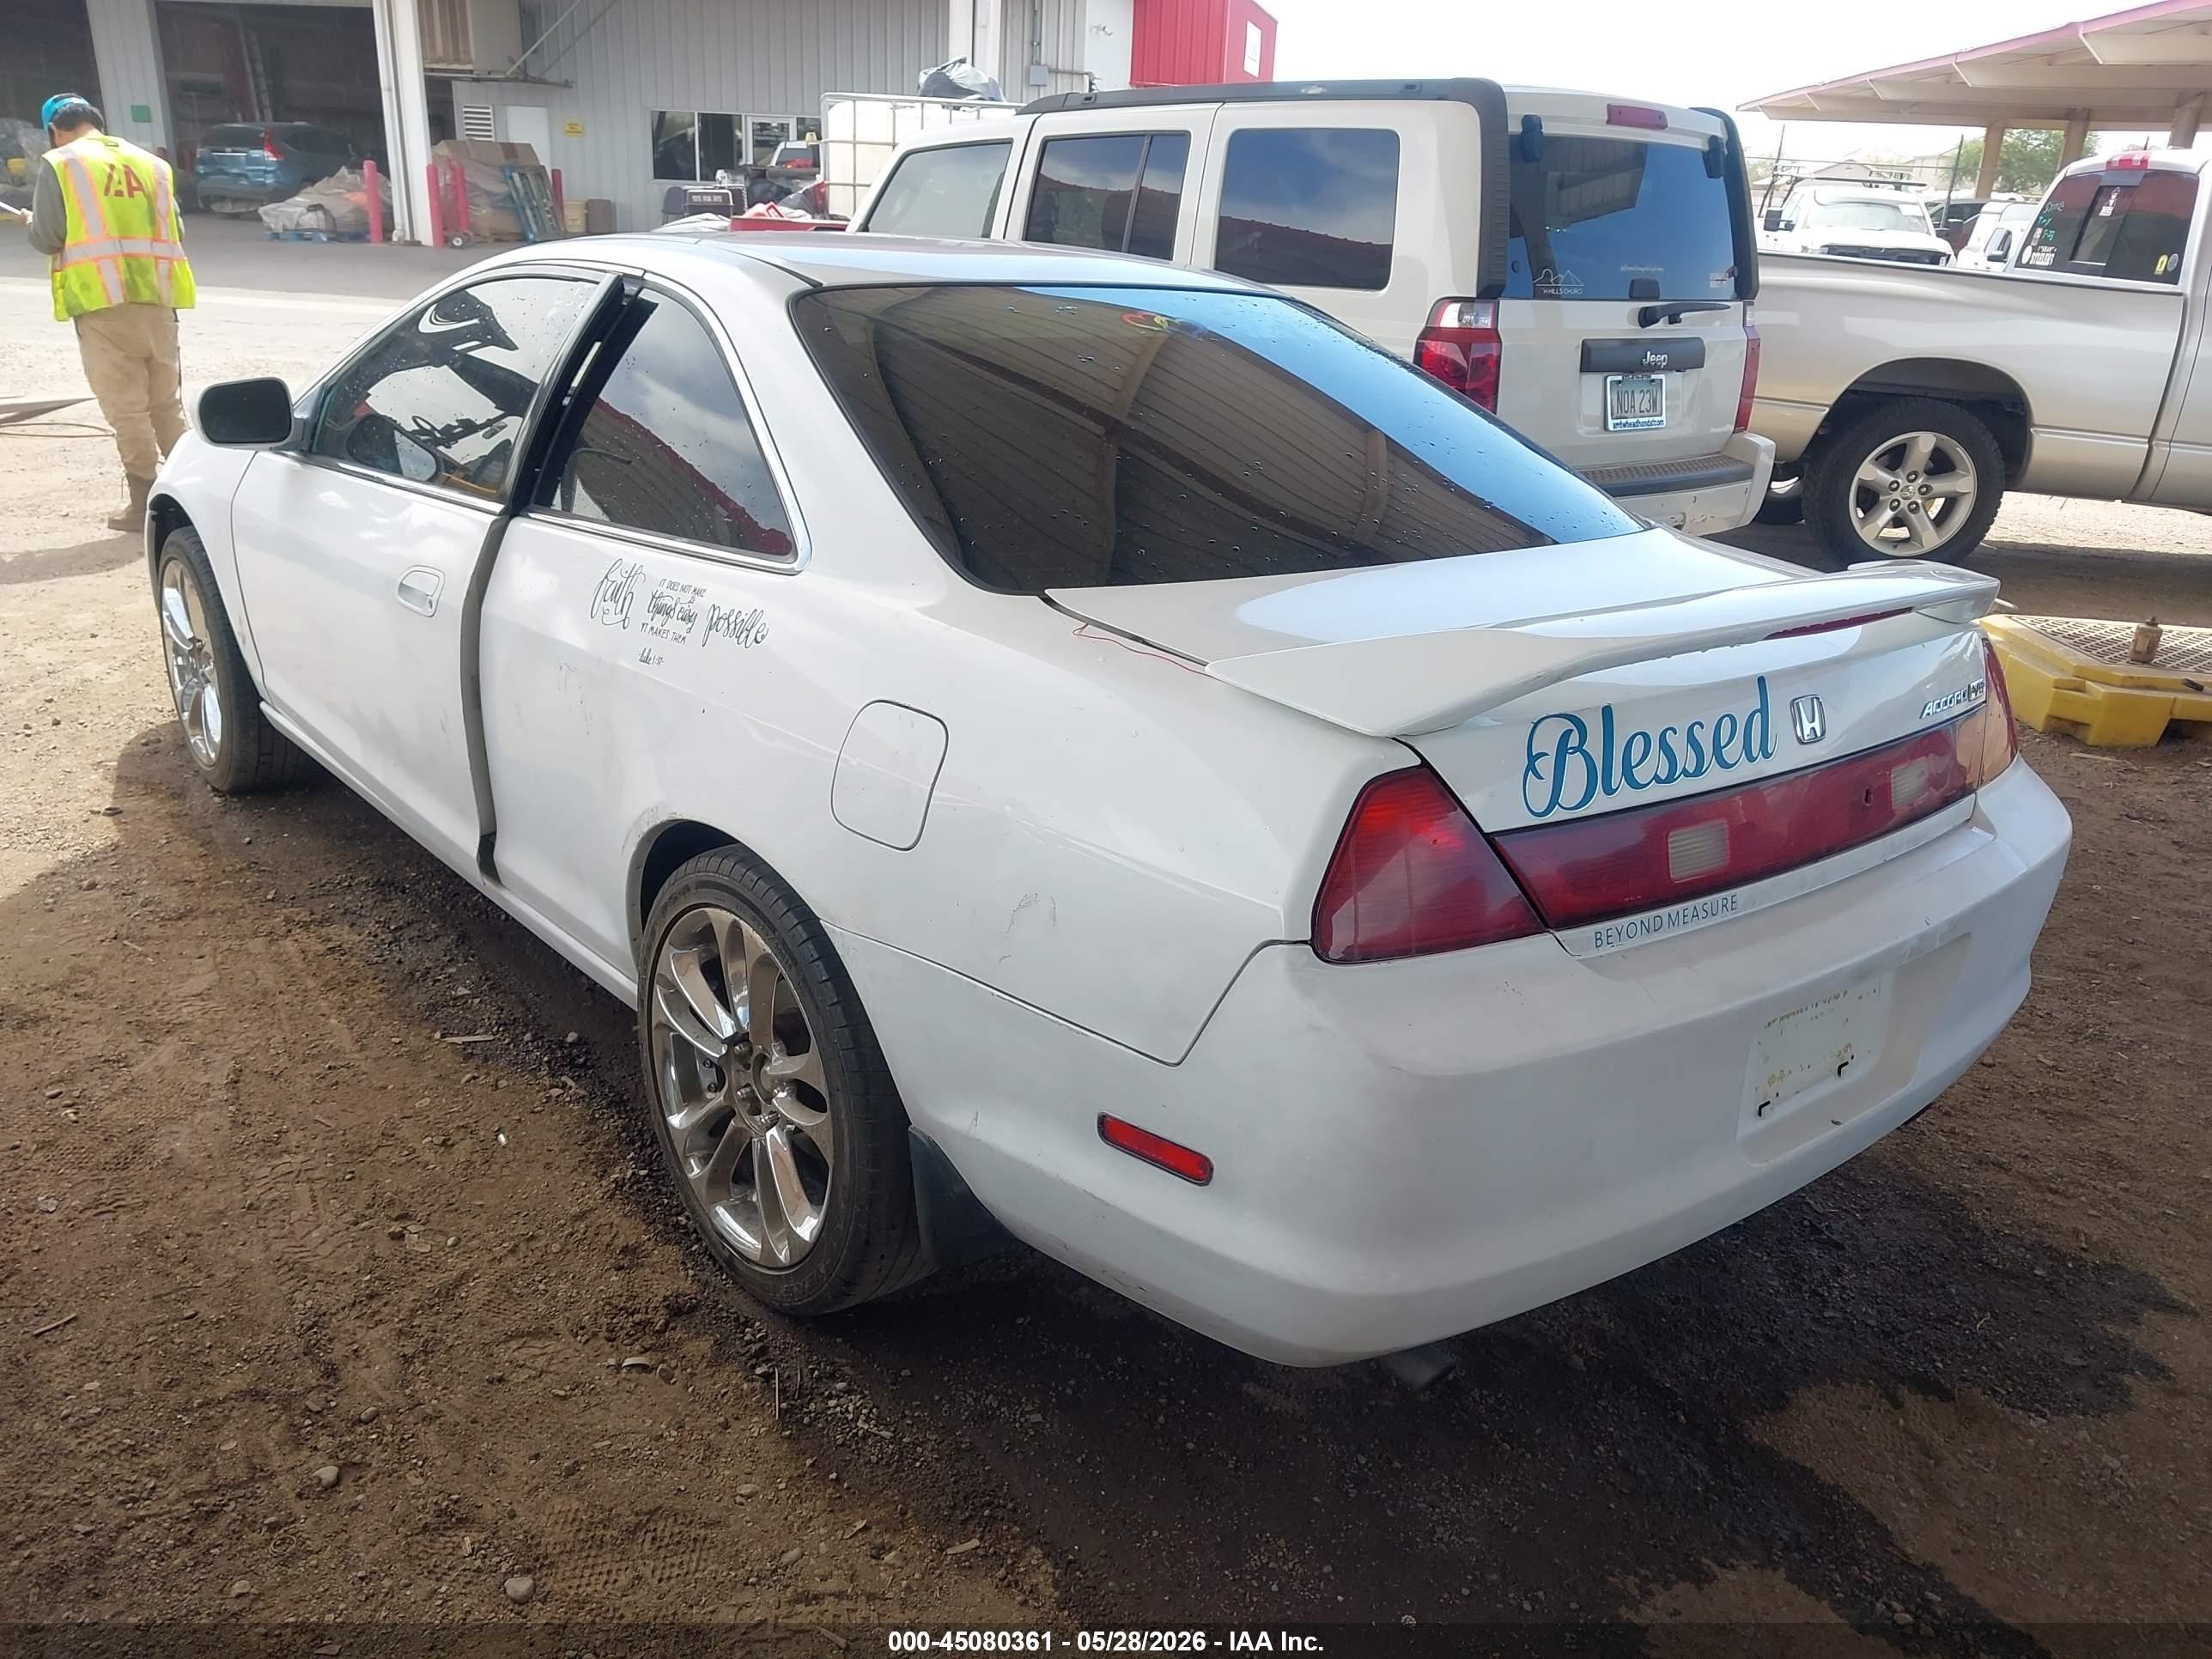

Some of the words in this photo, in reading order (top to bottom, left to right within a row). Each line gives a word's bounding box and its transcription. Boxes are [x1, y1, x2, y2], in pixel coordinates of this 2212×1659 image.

[1642, 350, 1668, 368] Jeep
[1616, 389, 1636, 414] NOA
[1638, 389, 1658, 414] 23W
[591, 557, 646, 629] faith
[659, 578, 667, 587] IT
[666, 580, 681, 592] DOES
[679, 584, 693, 594] NOT
[691, 586, 707, 598] MAKE
[647, 589, 680, 627] things
[677, 595, 698, 634] easy
[702, 603, 769, 649] possible
[640, 622, 649, 633] IT
[647, 625, 670, 640] MAKES
[670, 631, 687, 645] THEM
[1919, 688, 1967, 720] ACCORD
[1522, 674, 1778, 818] Blessed
[1594, 915, 1663, 949] BEYOND
[1667, 892, 1738, 930] MEASURE
